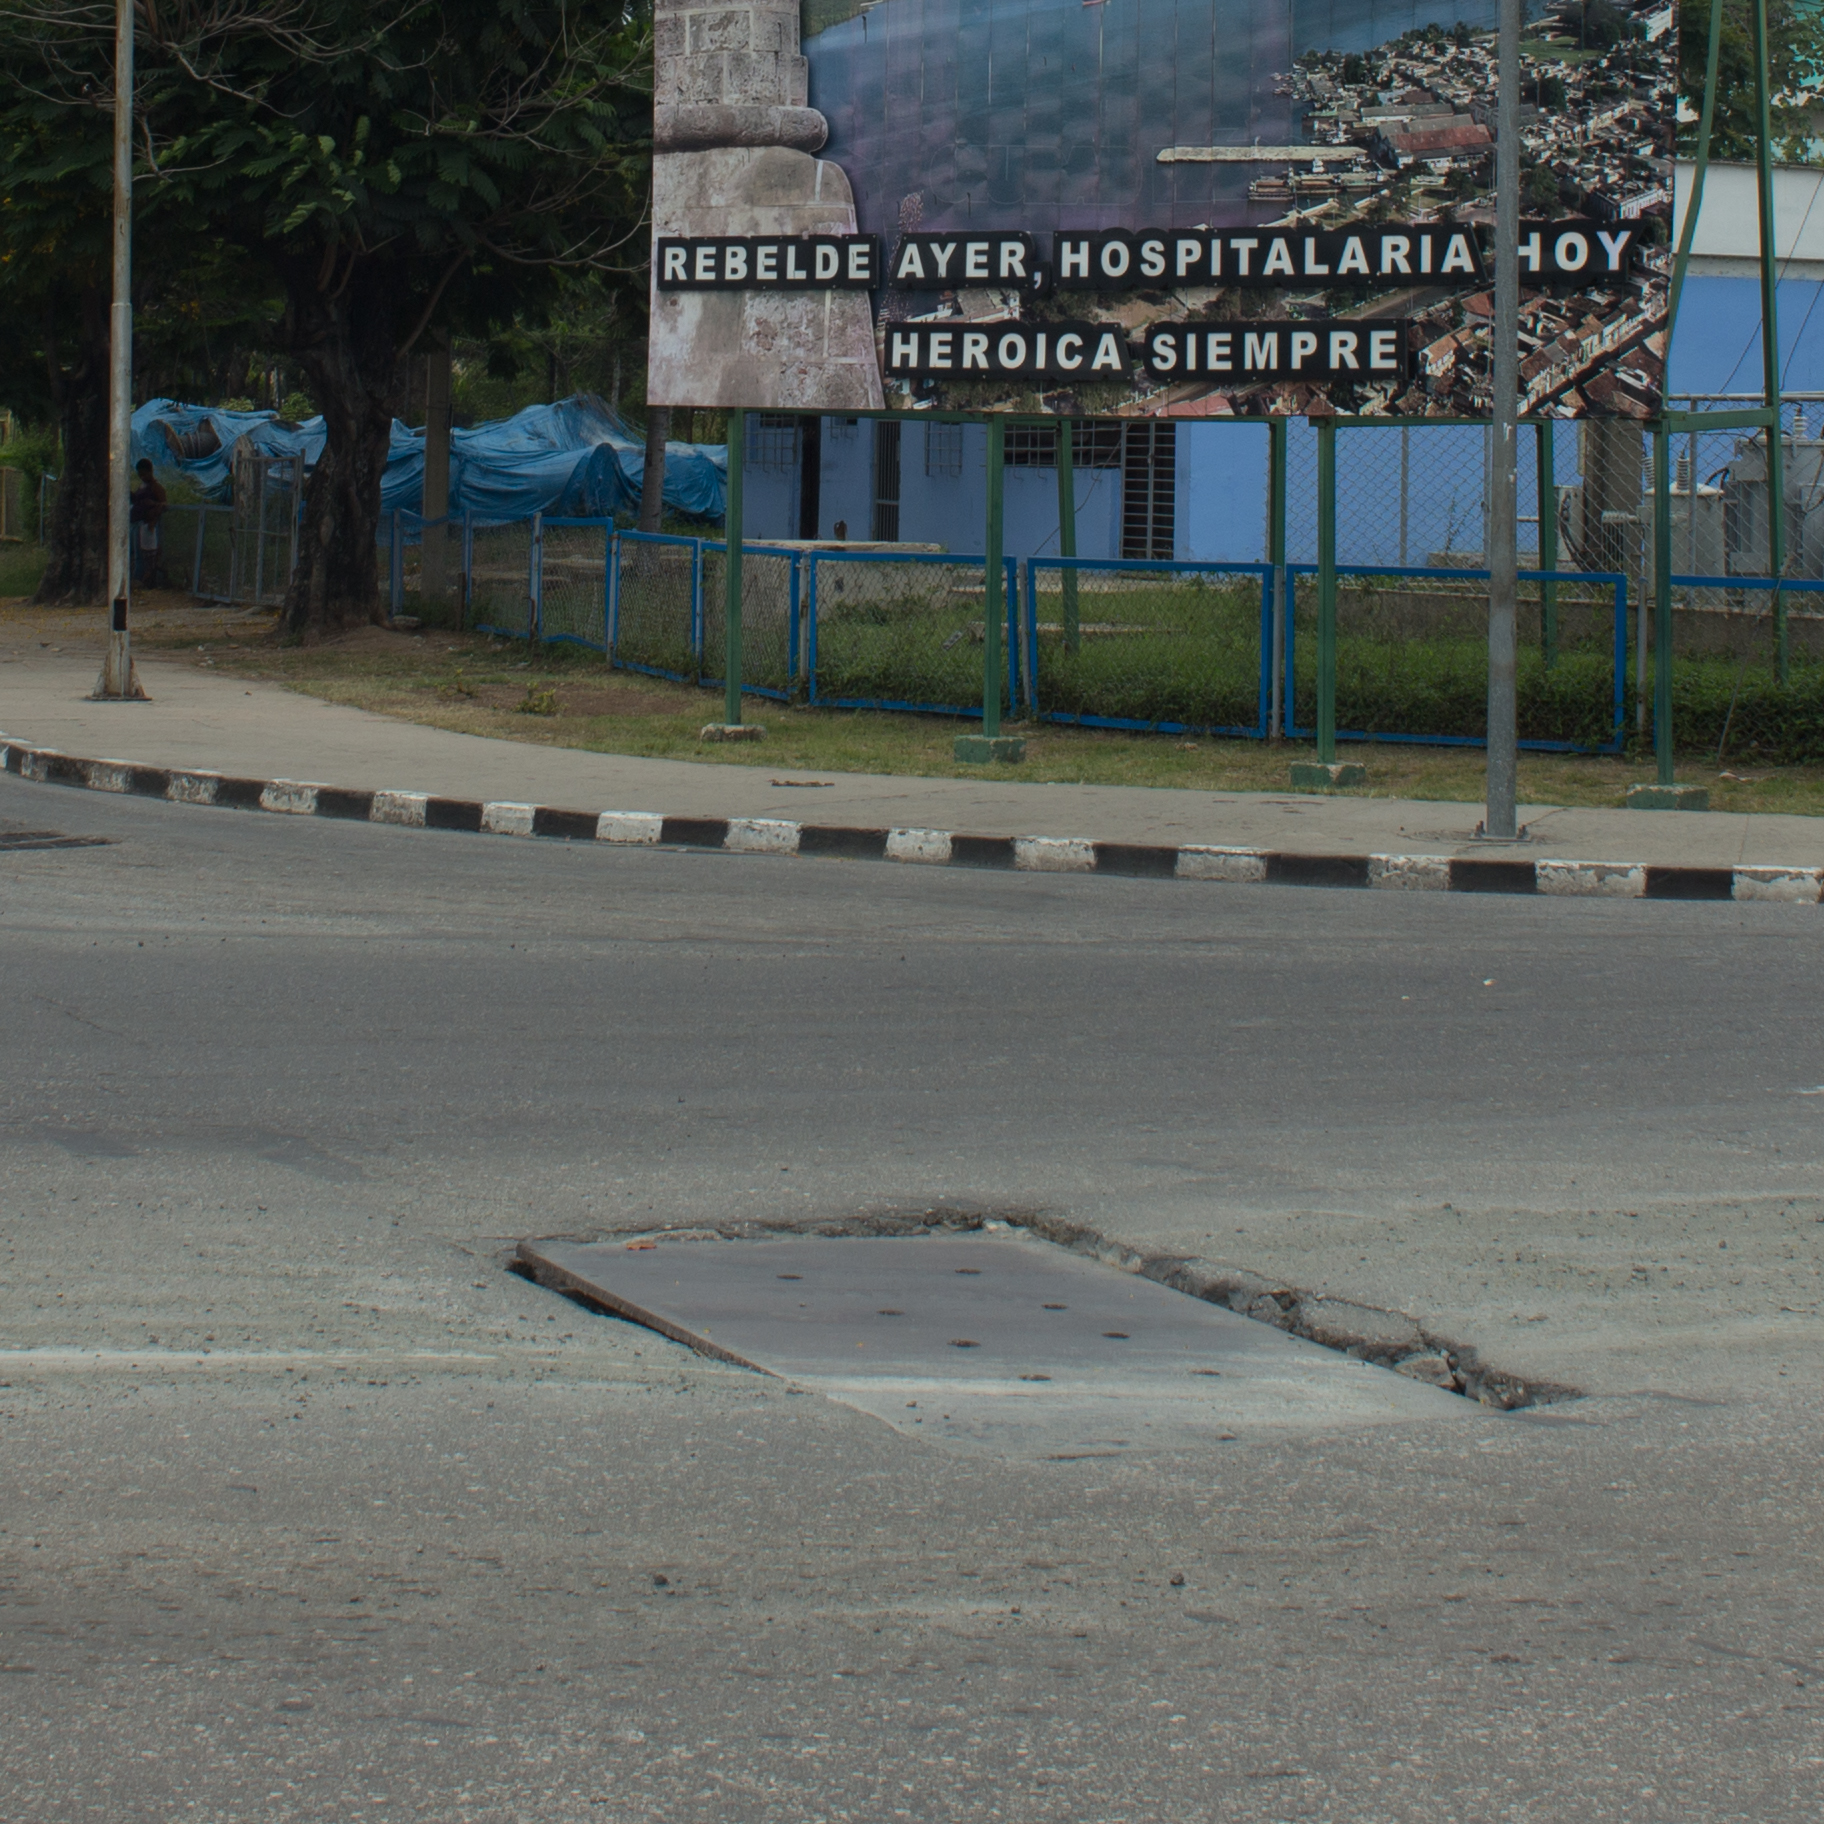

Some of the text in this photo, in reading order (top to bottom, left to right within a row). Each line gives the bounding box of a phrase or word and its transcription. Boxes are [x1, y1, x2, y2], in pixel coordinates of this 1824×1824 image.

[663, 231, 1632, 289] REBELDE AYER, HOSPITALARIA HOY
[891, 330, 1398, 371] HEROICA SIEMPRE
